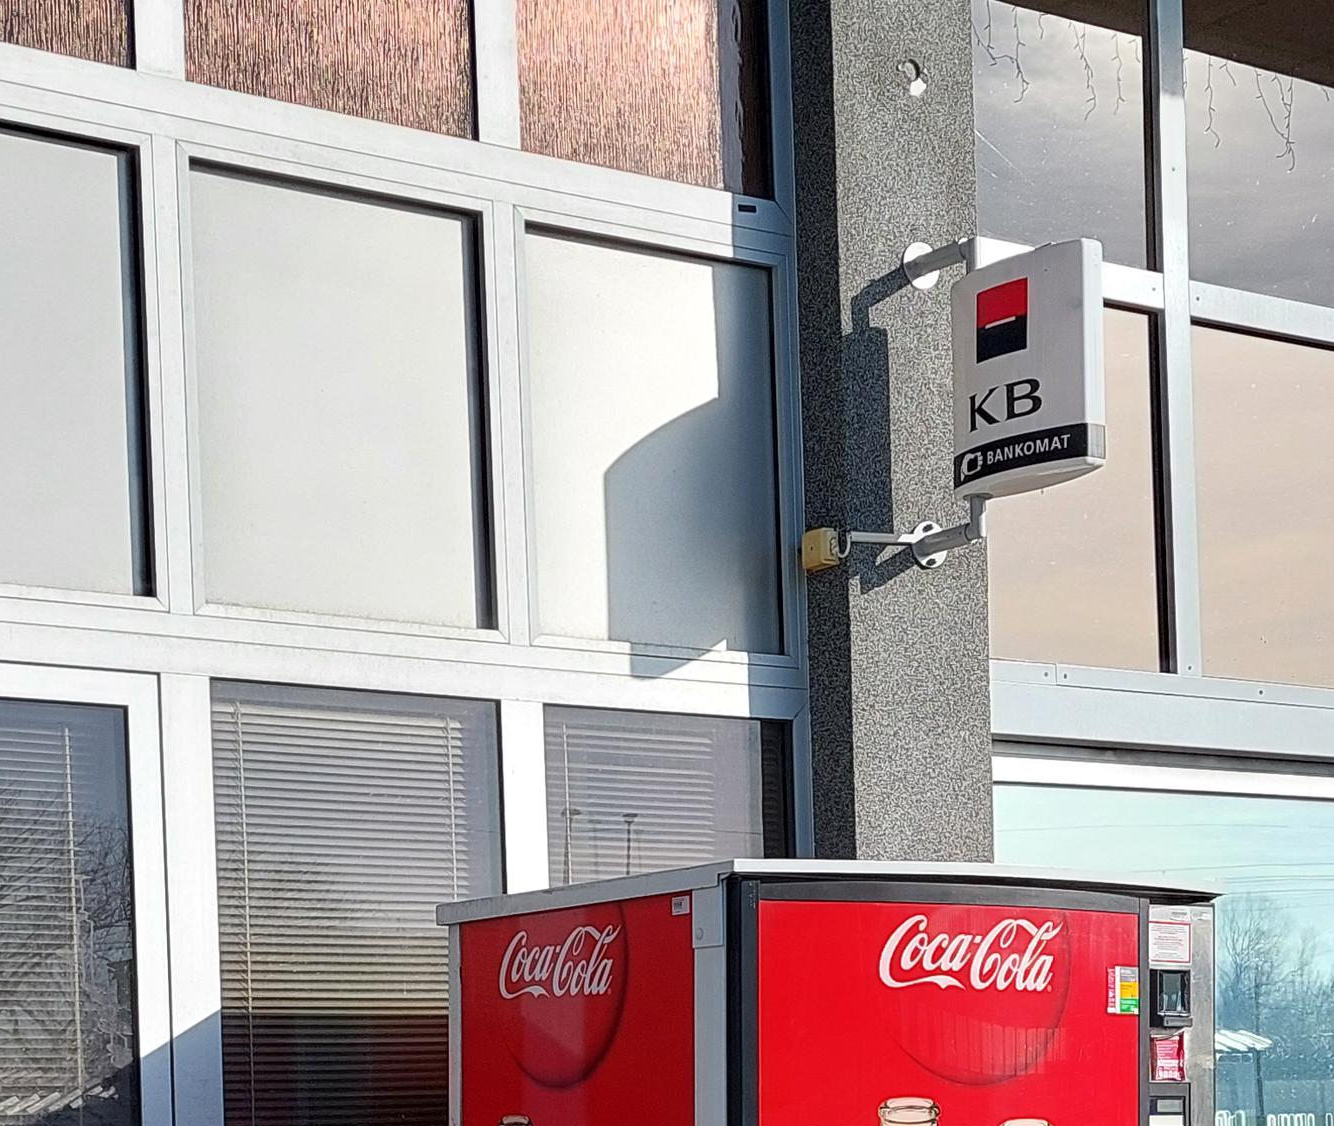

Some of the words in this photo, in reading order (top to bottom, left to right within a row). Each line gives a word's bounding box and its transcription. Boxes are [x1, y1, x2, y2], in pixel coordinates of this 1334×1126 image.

[969, 378, 1043, 433] KB
[986, 434, 1071, 465] BANKOMAT
[499, 924, 622, 999] Coca-Cola
[879, 914, 1063, 992] Coca-Cola
